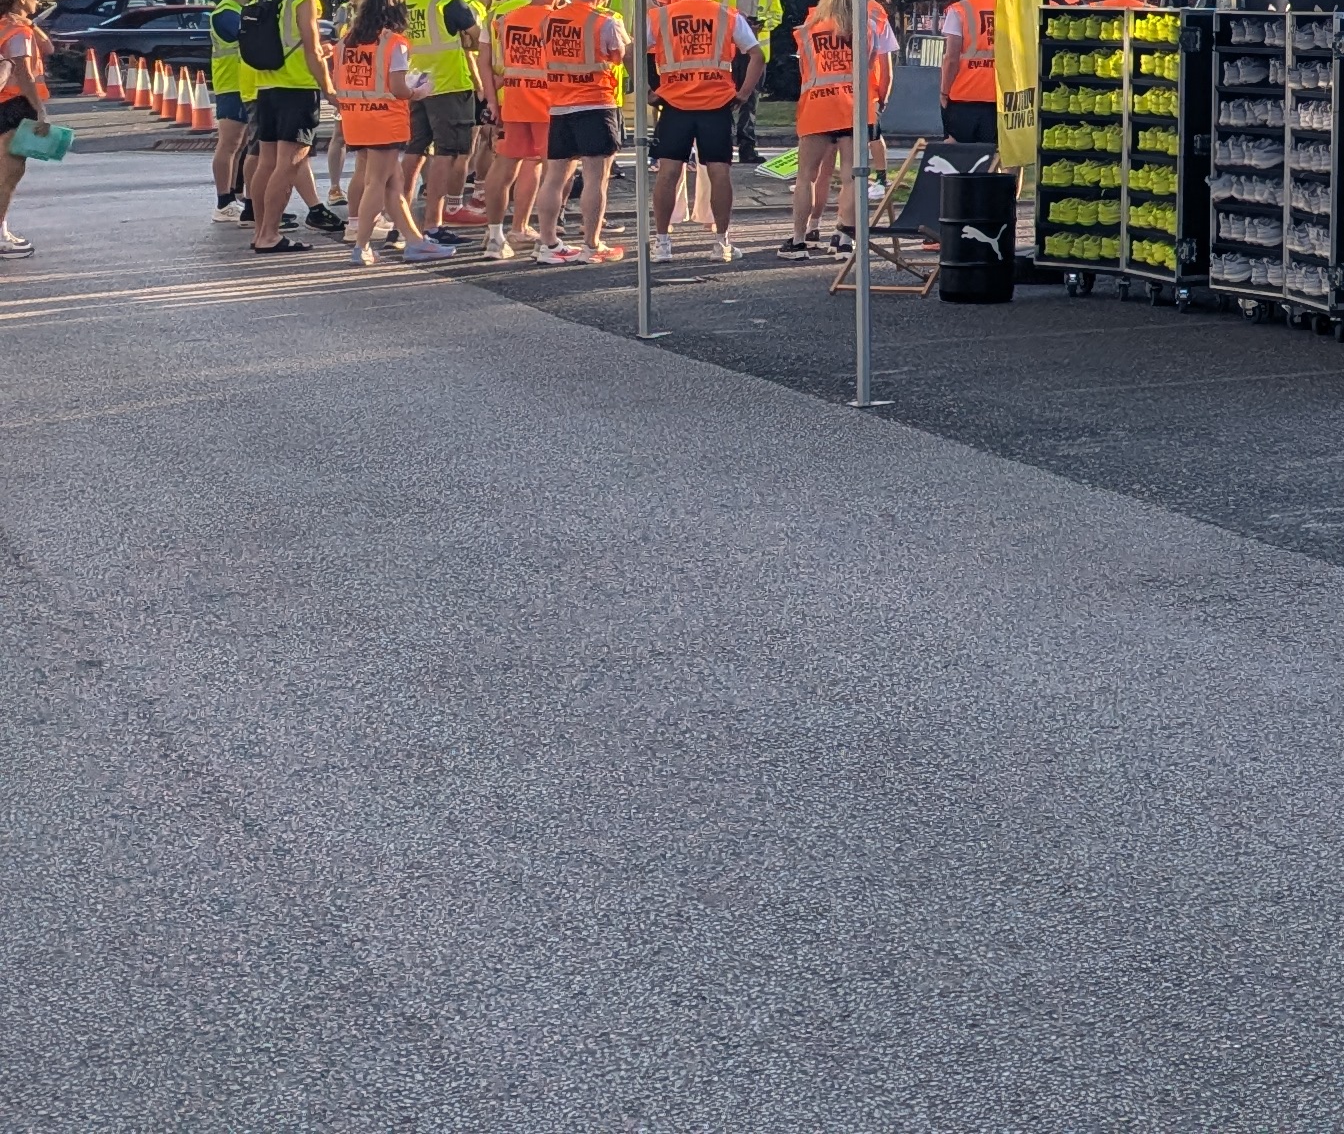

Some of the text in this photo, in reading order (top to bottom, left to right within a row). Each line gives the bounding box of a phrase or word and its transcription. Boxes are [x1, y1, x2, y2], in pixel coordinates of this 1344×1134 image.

[409, 9, 426, 21] UN
[552, 24, 581, 40] RUN
[677, 18, 714, 34] RUN
[512, 32, 544, 48] RUN
[552, 37, 581, 49] NORTH
[679, 33, 712, 44] NORTH
[510, 44, 542, 57] NORTH
[552, 47, 581, 58] WEST
[681, 43, 712, 55] WEST
[821, 49, 853, 61] NORTH
[346, 49, 373, 66] RUN
[510, 54, 541, 66] WEST
